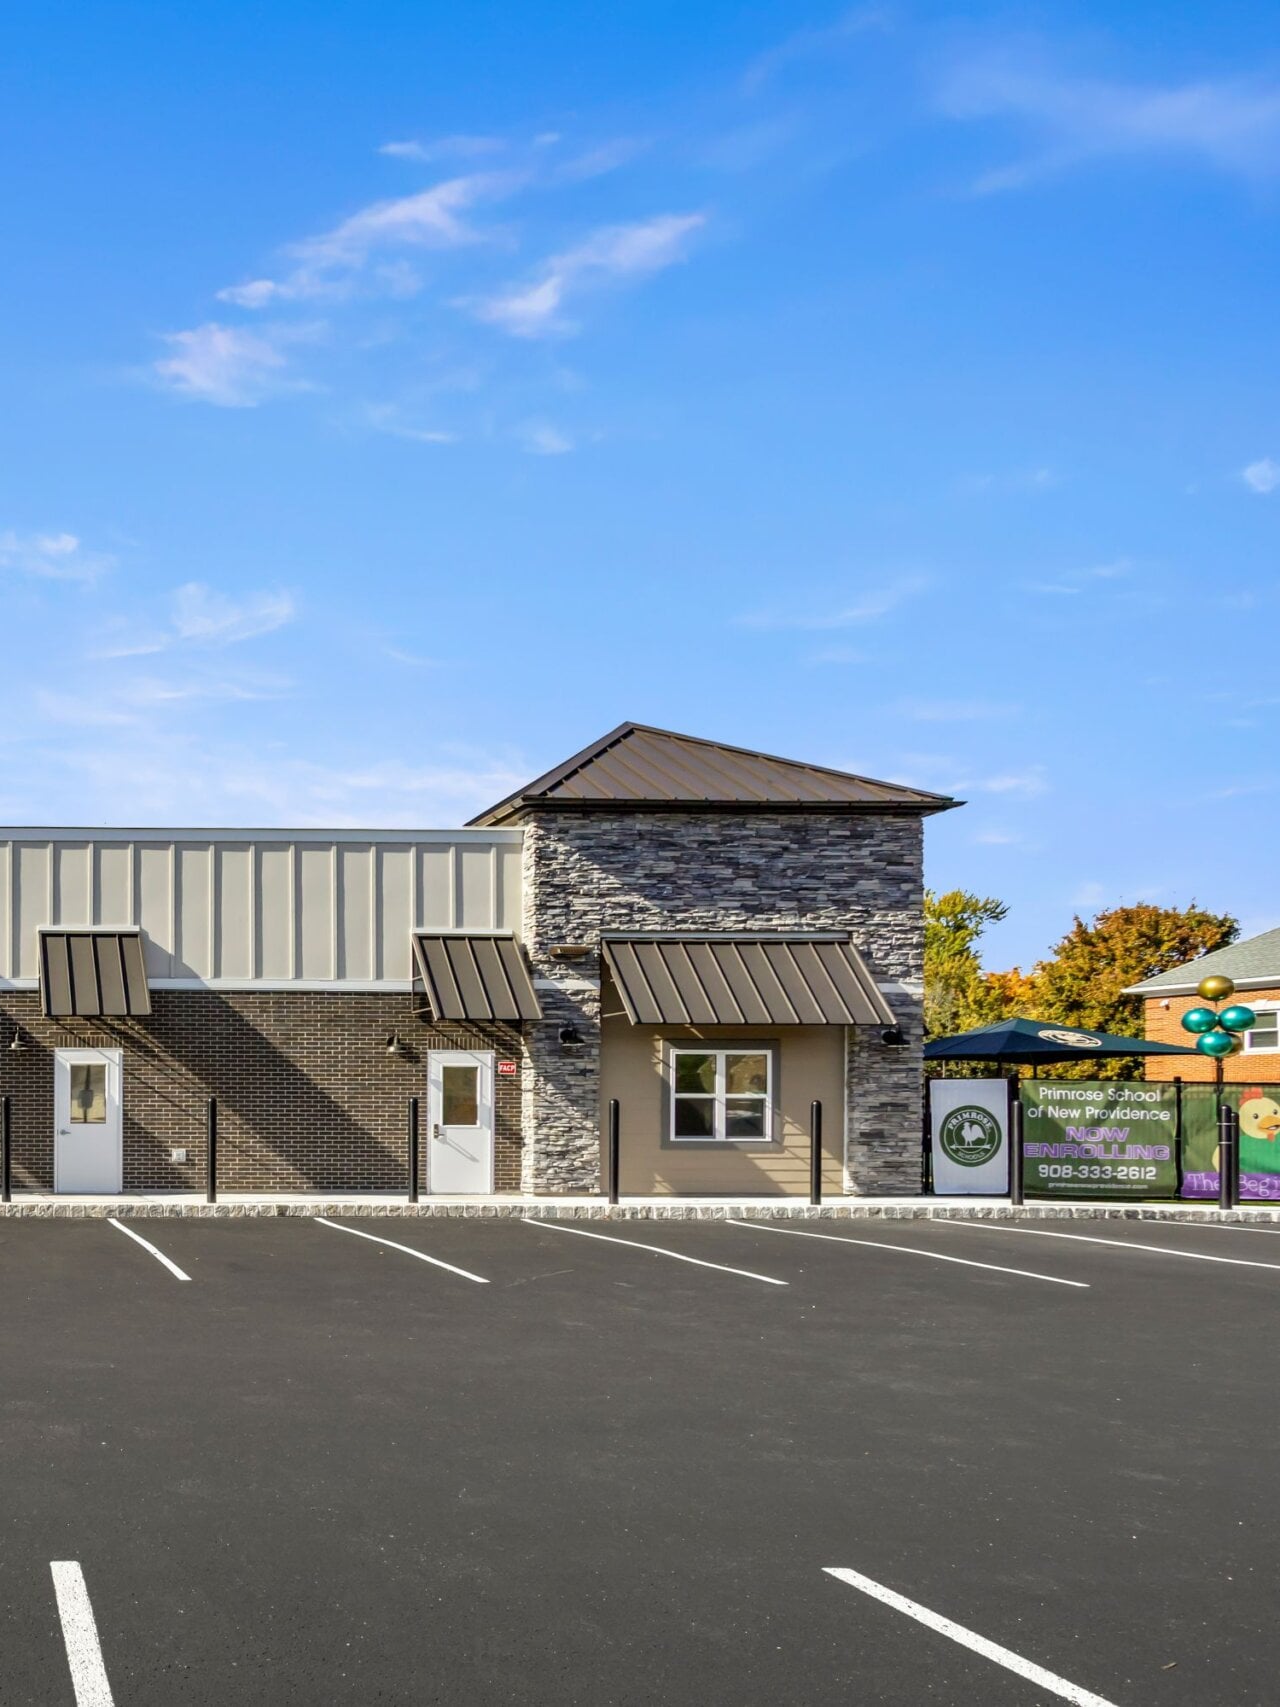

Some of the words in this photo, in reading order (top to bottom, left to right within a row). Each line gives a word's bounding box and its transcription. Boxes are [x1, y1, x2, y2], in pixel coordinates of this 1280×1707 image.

[1039, 1087, 1104, 1100] Primrose
[1108, 1088, 1161, 1102] School
[1027, 1105, 1044, 1118] of
[1047, 1105, 1081, 1119] New
[1085, 1106, 1171, 1120] Providence
[948, 1112, 993, 1130] PRIMROSE
[1065, 1126, 1130, 1142] NOW
[1023, 1143, 1170, 1160] ENROLLING
[1038, 1165, 1157, 1180] 908-333-2612
[1187, 1173, 1219, 1191] The
